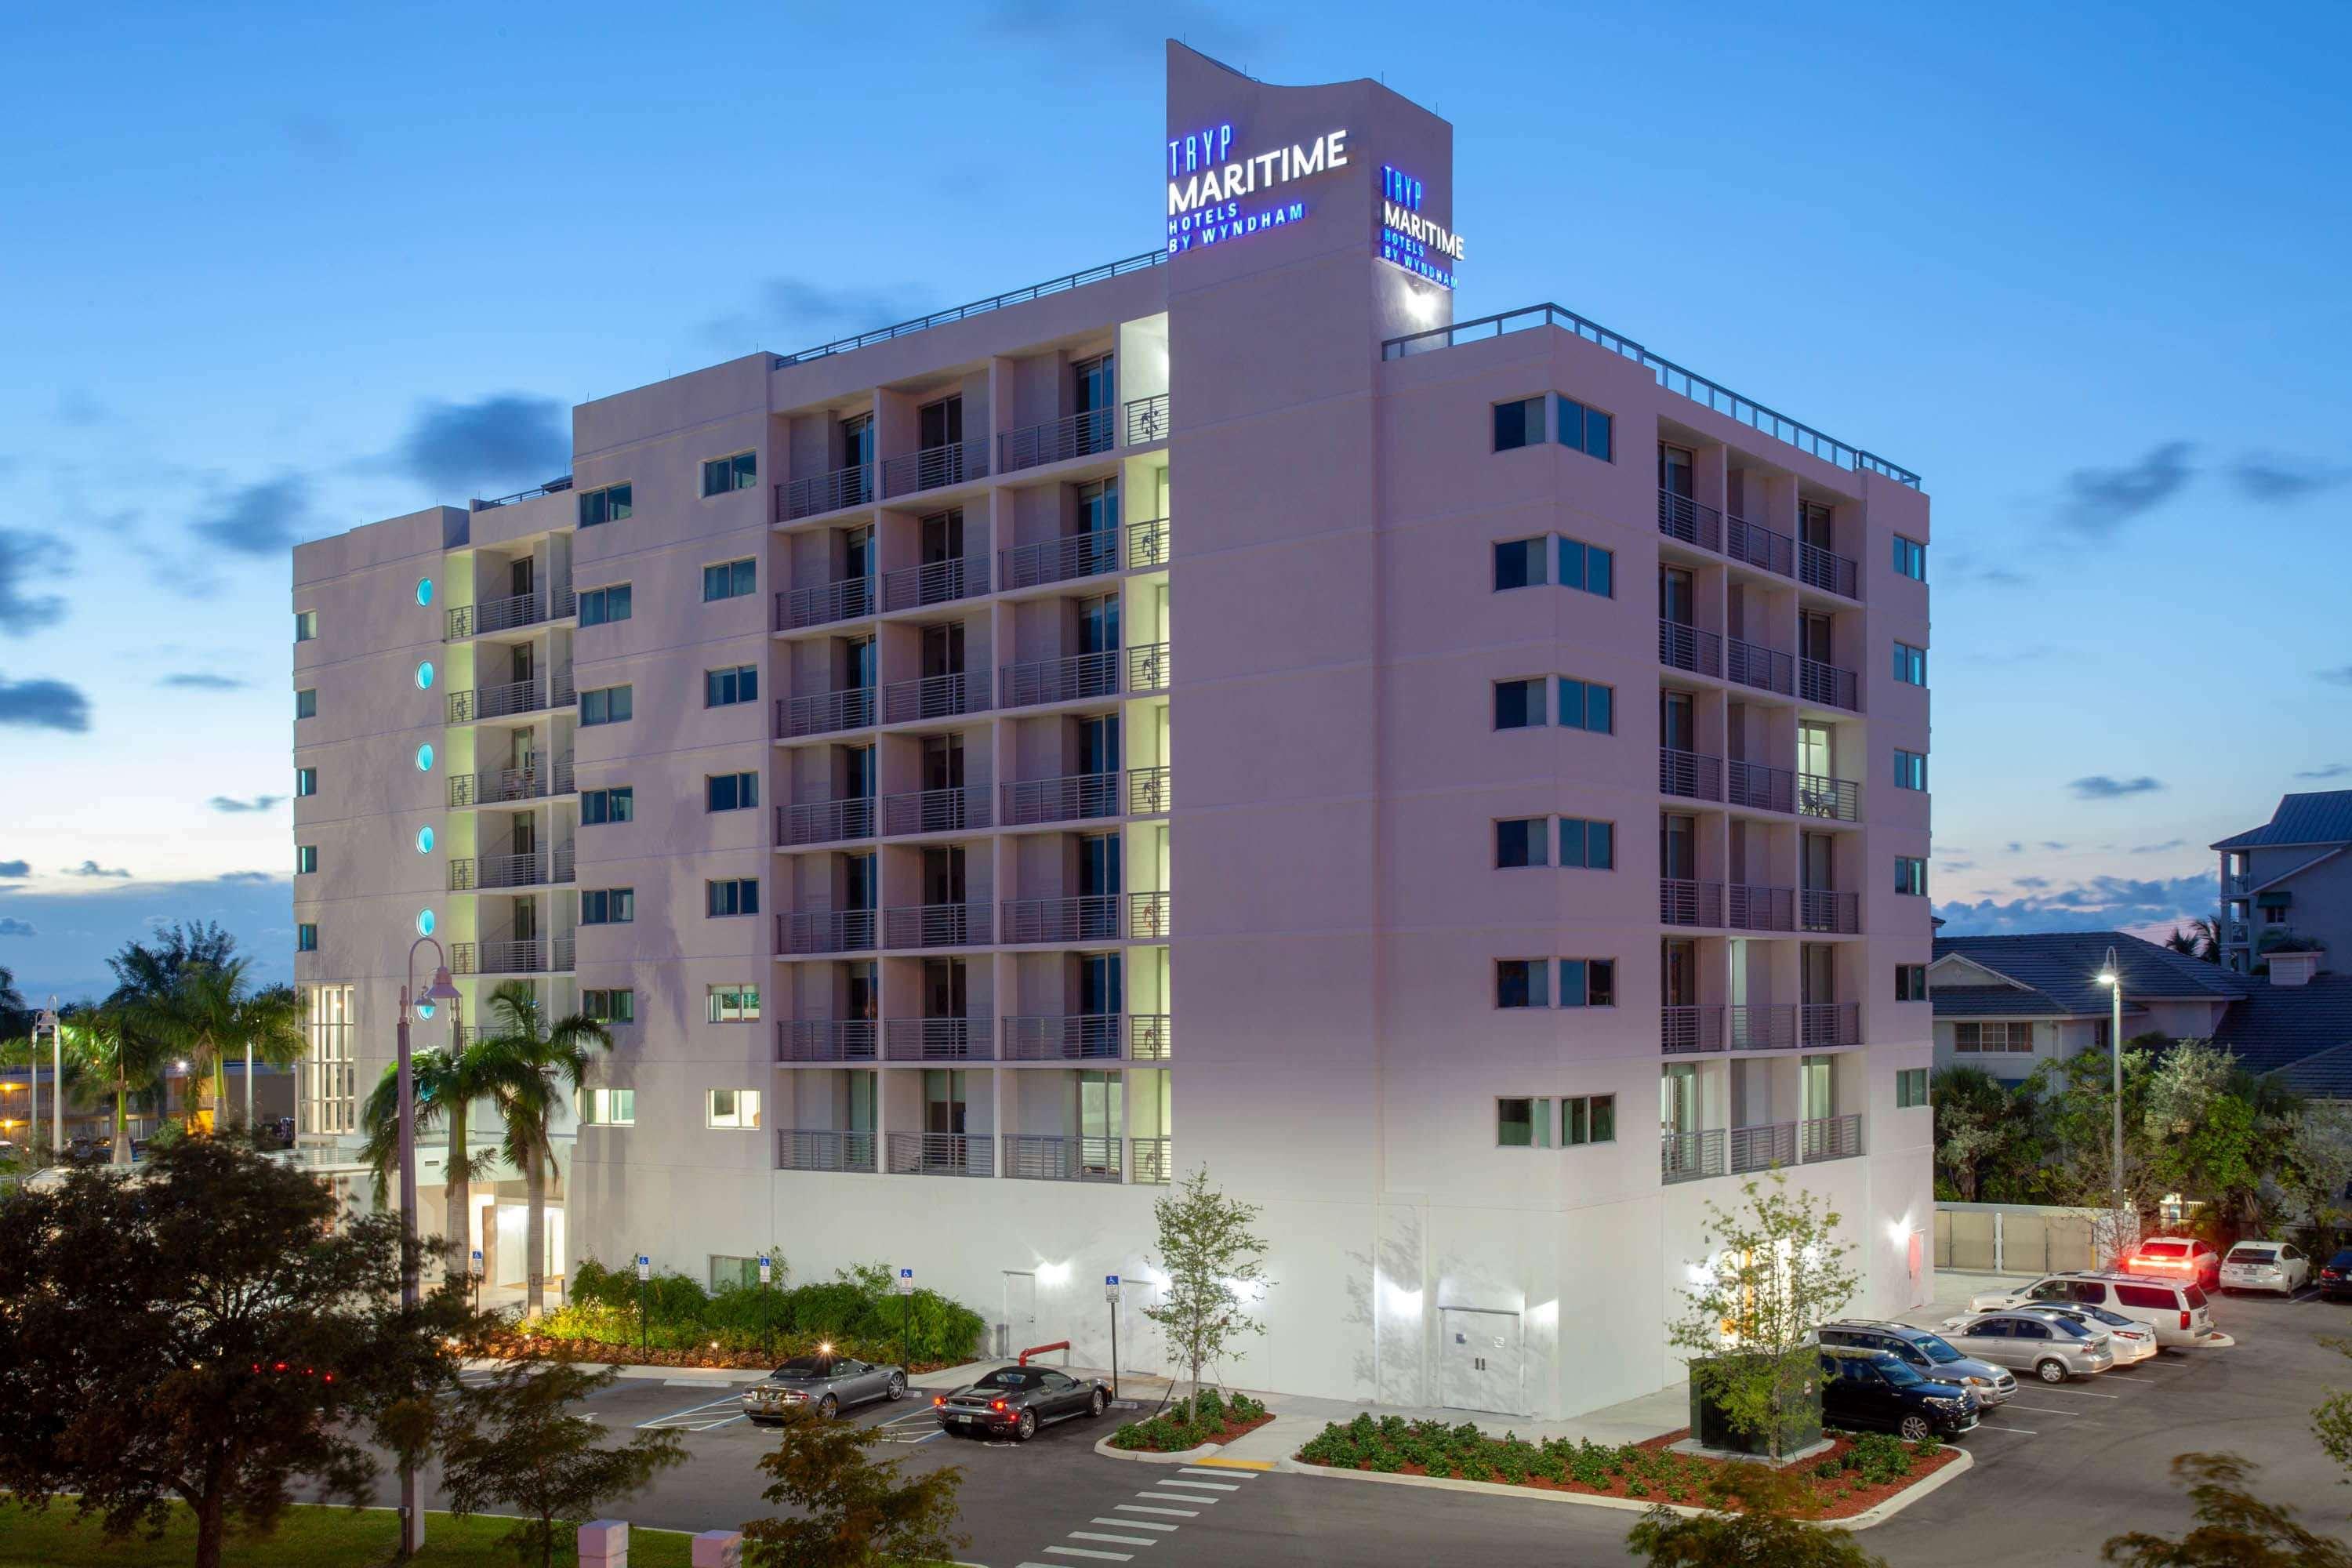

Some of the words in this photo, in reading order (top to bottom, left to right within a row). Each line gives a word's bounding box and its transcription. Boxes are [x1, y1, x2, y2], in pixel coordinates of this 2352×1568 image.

[1168, 129, 1348, 216] MARITIME
[1169, 124, 1232, 176] TRYP
[1384, 165, 1421, 211] TRYP
[1169, 202, 1238, 235] HOTELS
[1169, 235, 1192, 253] BY
[1202, 203, 1305, 244] WYNDHAM
[1384, 200, 1465, 260] MARITIME
[1385, 228, 1424, 257] HOTELS
[1385, 245, 1398, 262] BY
[1405, 253, 1458, 289] WYNDHAM
